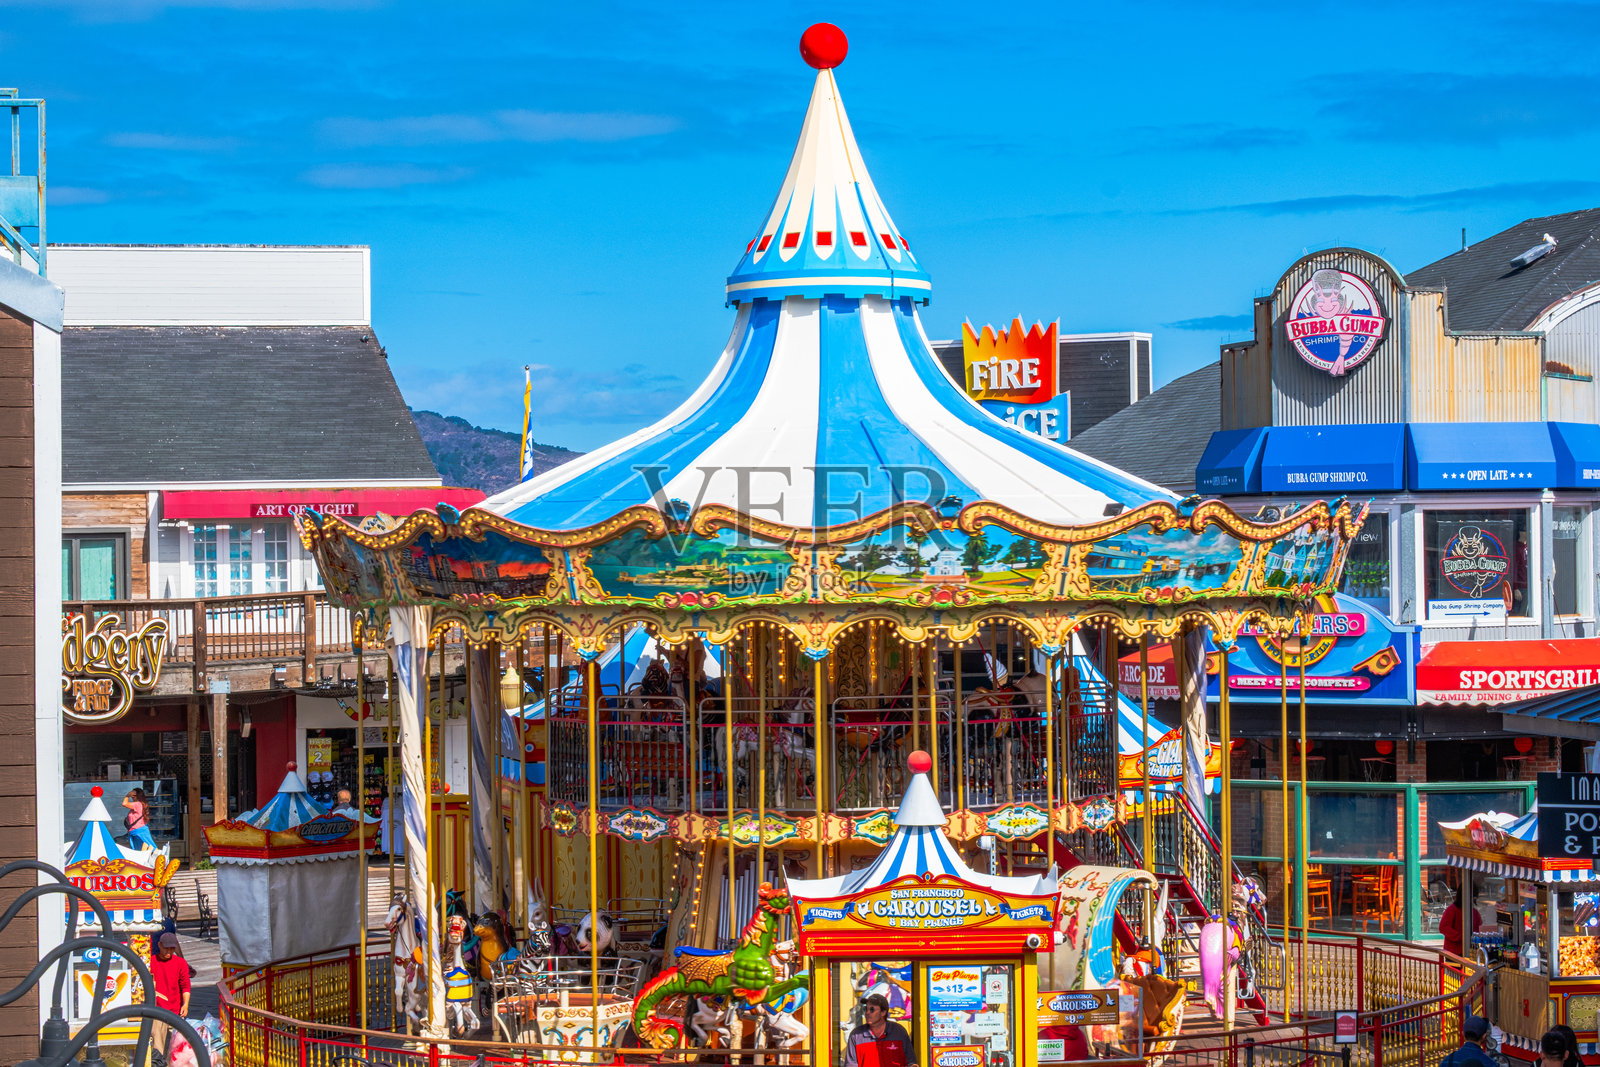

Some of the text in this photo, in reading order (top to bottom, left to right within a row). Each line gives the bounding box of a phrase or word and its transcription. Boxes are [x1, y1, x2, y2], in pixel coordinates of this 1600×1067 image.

[1290, 315, 1380, 338] BUBBA GUMP
[1305, 335, 1341, 347] SHRIMP
[1296, 340, 1332, 369] RESTAURANT
[1352, 338, 1375, 362] MARKET
[1287, 471, 1368, 484] BUBBA GUMP SHRIMP CO.
[1467, 470, 1509, 481] OPEN LATE
[256, 503, 355, 516] ART OF LIGHT
[1444, 557, 1507, 573] BUBBA GUMP
[1449, 603, 1462, 611] Gump
[1464, 602, 1481, 611] Shrimp
[1482, 602, 1504, 611] Company
[61, 613, 169, 716] dgery
[1124, 664, 1165, 683] ARCDE
[72, 680, 114, 696] FUDGE
[1237, 678, 1267, 687] MEET
[1304, 677, 1356, 688] COMPETE
[74, 695, 110, 711] & FUN
[1435, 693, 1472, 701] FAMILY
[1477, 693, 1512, 701] DINING
[1515, 693, 1523, 701] &
[1563, 835, 1582, 855] &
[67, 873, 157, 892] HURROS
[890, 888, 965, 899] SAN FRANCISCO
[810, 907, 843, 919] TICKETS
[873, 898, 982, 918] CAROUSEL
[1010, 906, 1044, 920] TICKETS
[888, 917, 964, 928] & BAY PLUNGE
[932, 969, 979, 982] Bay Plunge
[946, 984, 963, 993] $13
[1049, 1000, 1099, 1011] CAROUSEL
[938, 1057, 979, 1066] CAROUSEL
